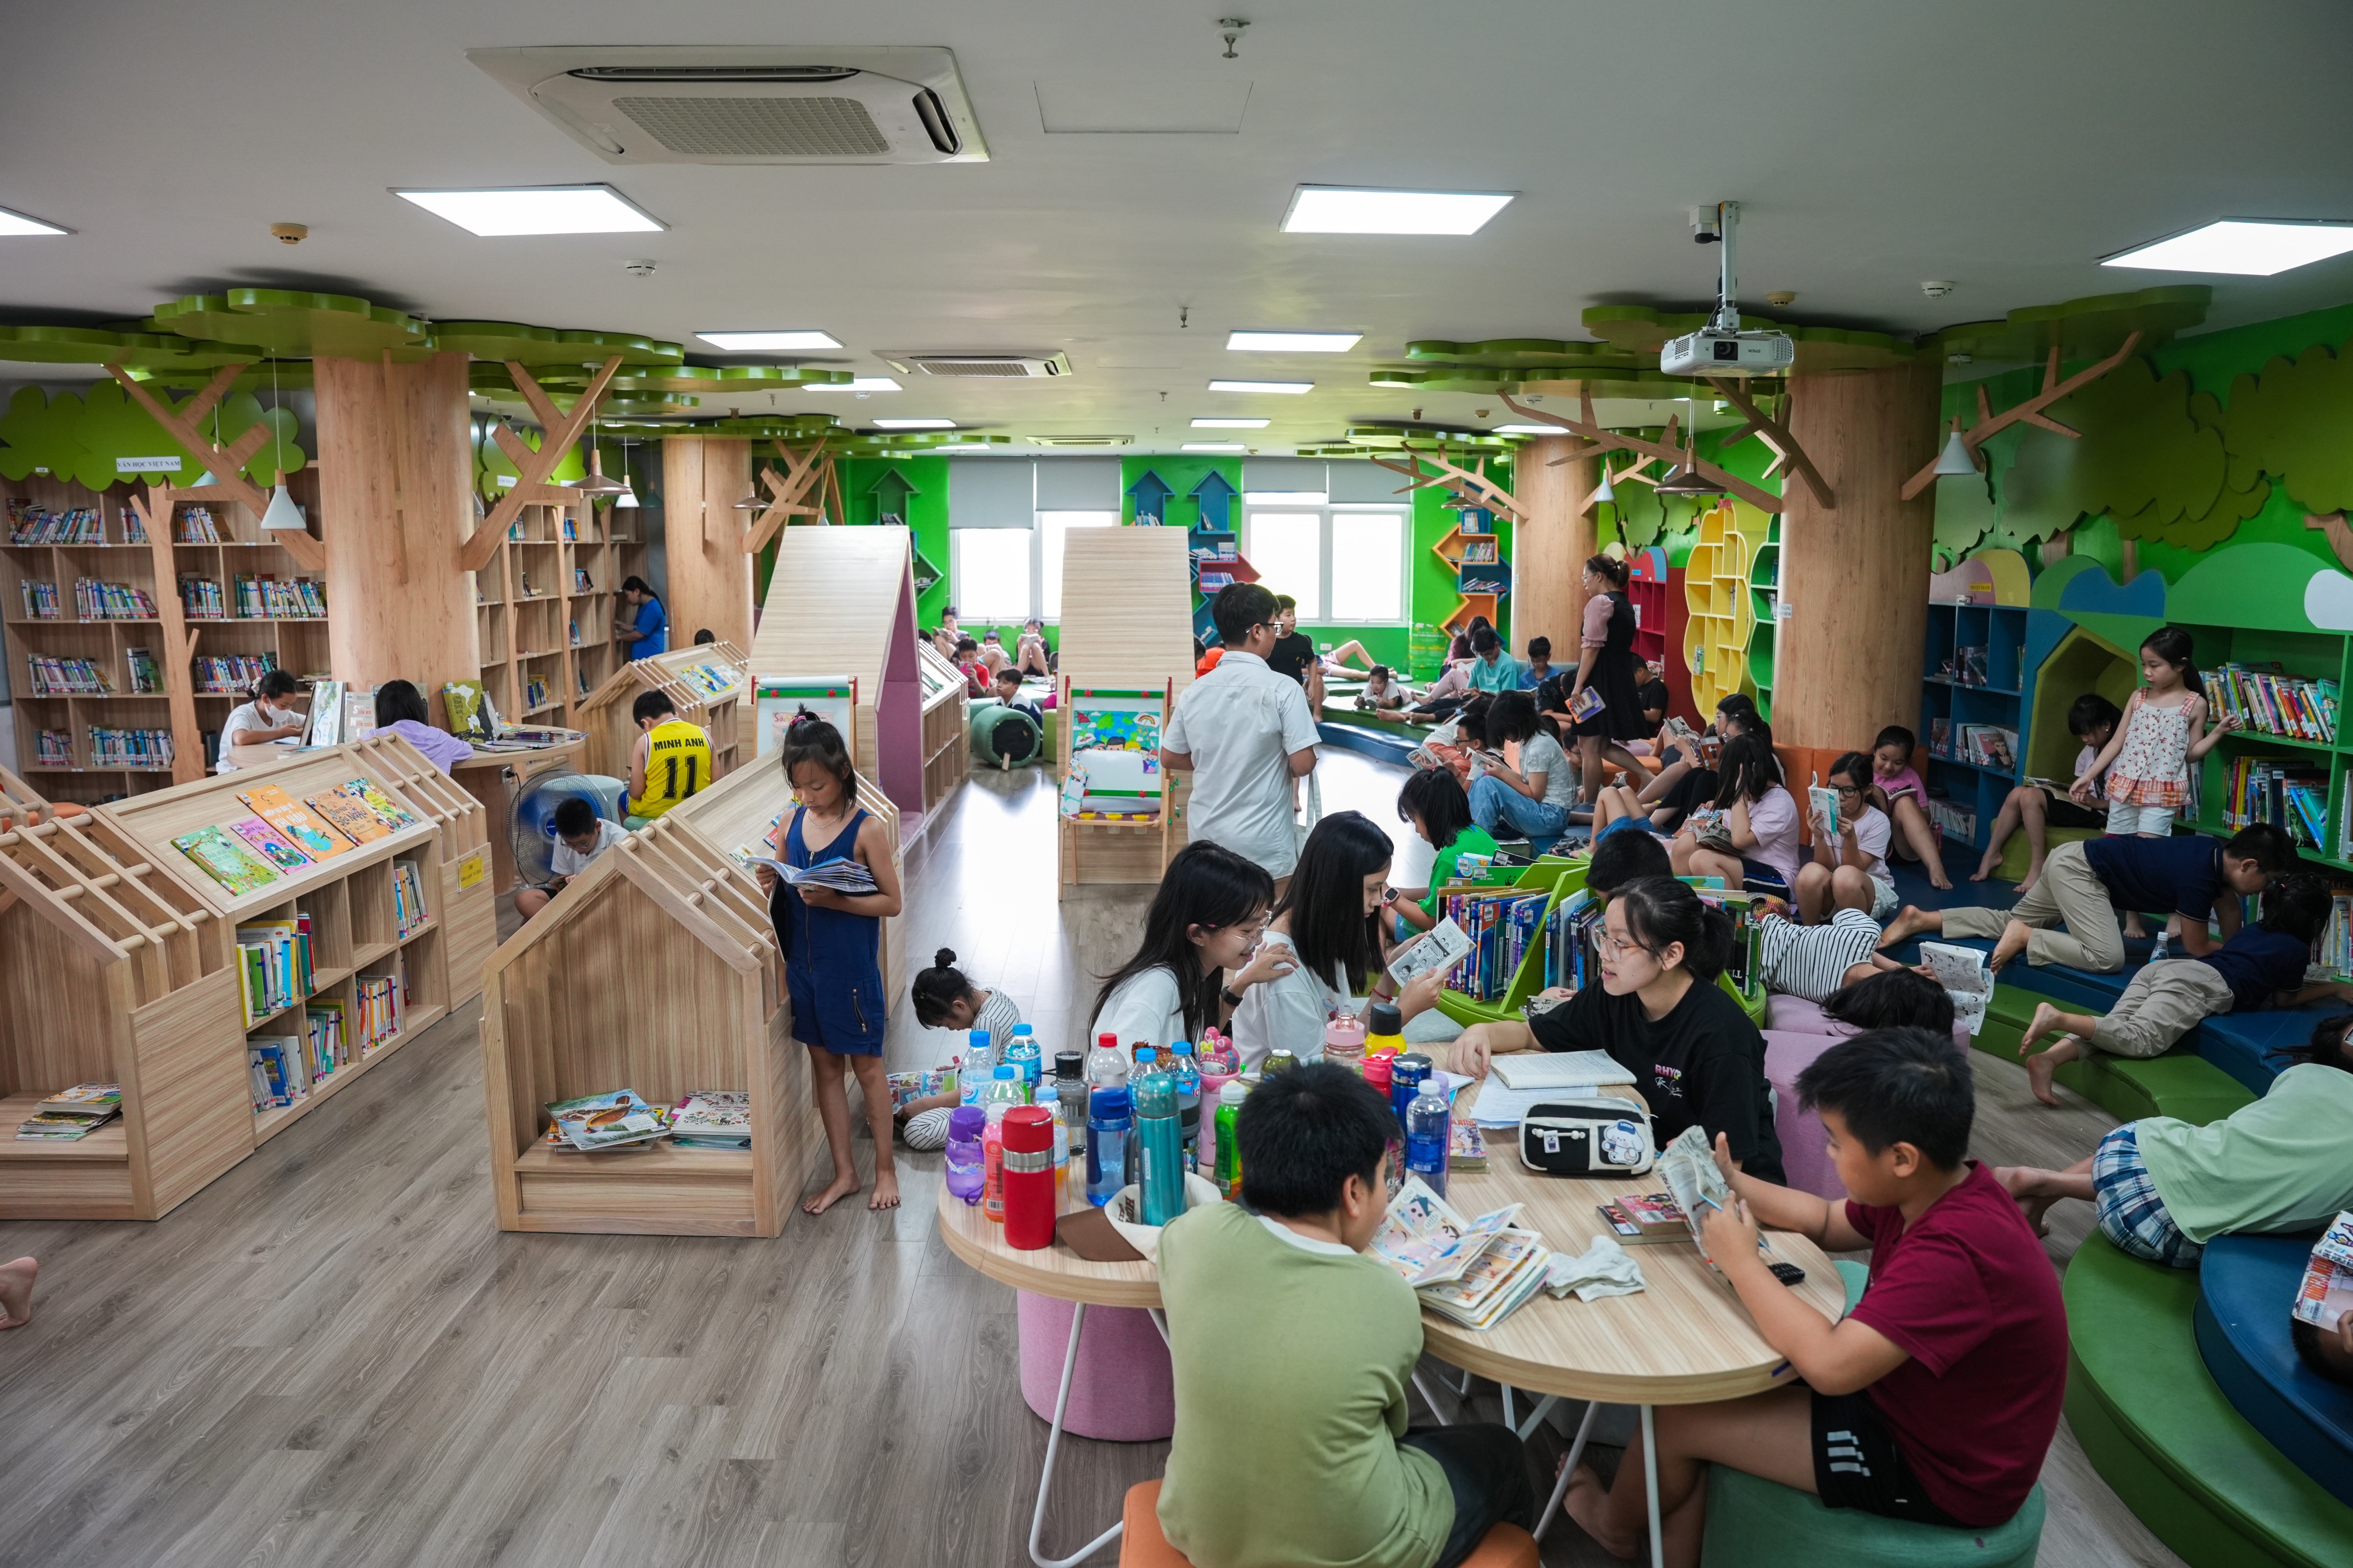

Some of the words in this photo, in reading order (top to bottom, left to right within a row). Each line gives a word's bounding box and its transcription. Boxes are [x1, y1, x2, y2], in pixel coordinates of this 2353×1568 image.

[654, 739, 682, 751] MINH
[685, 738, 704, 747] ANH
[662, 755, 697, 800] 11
